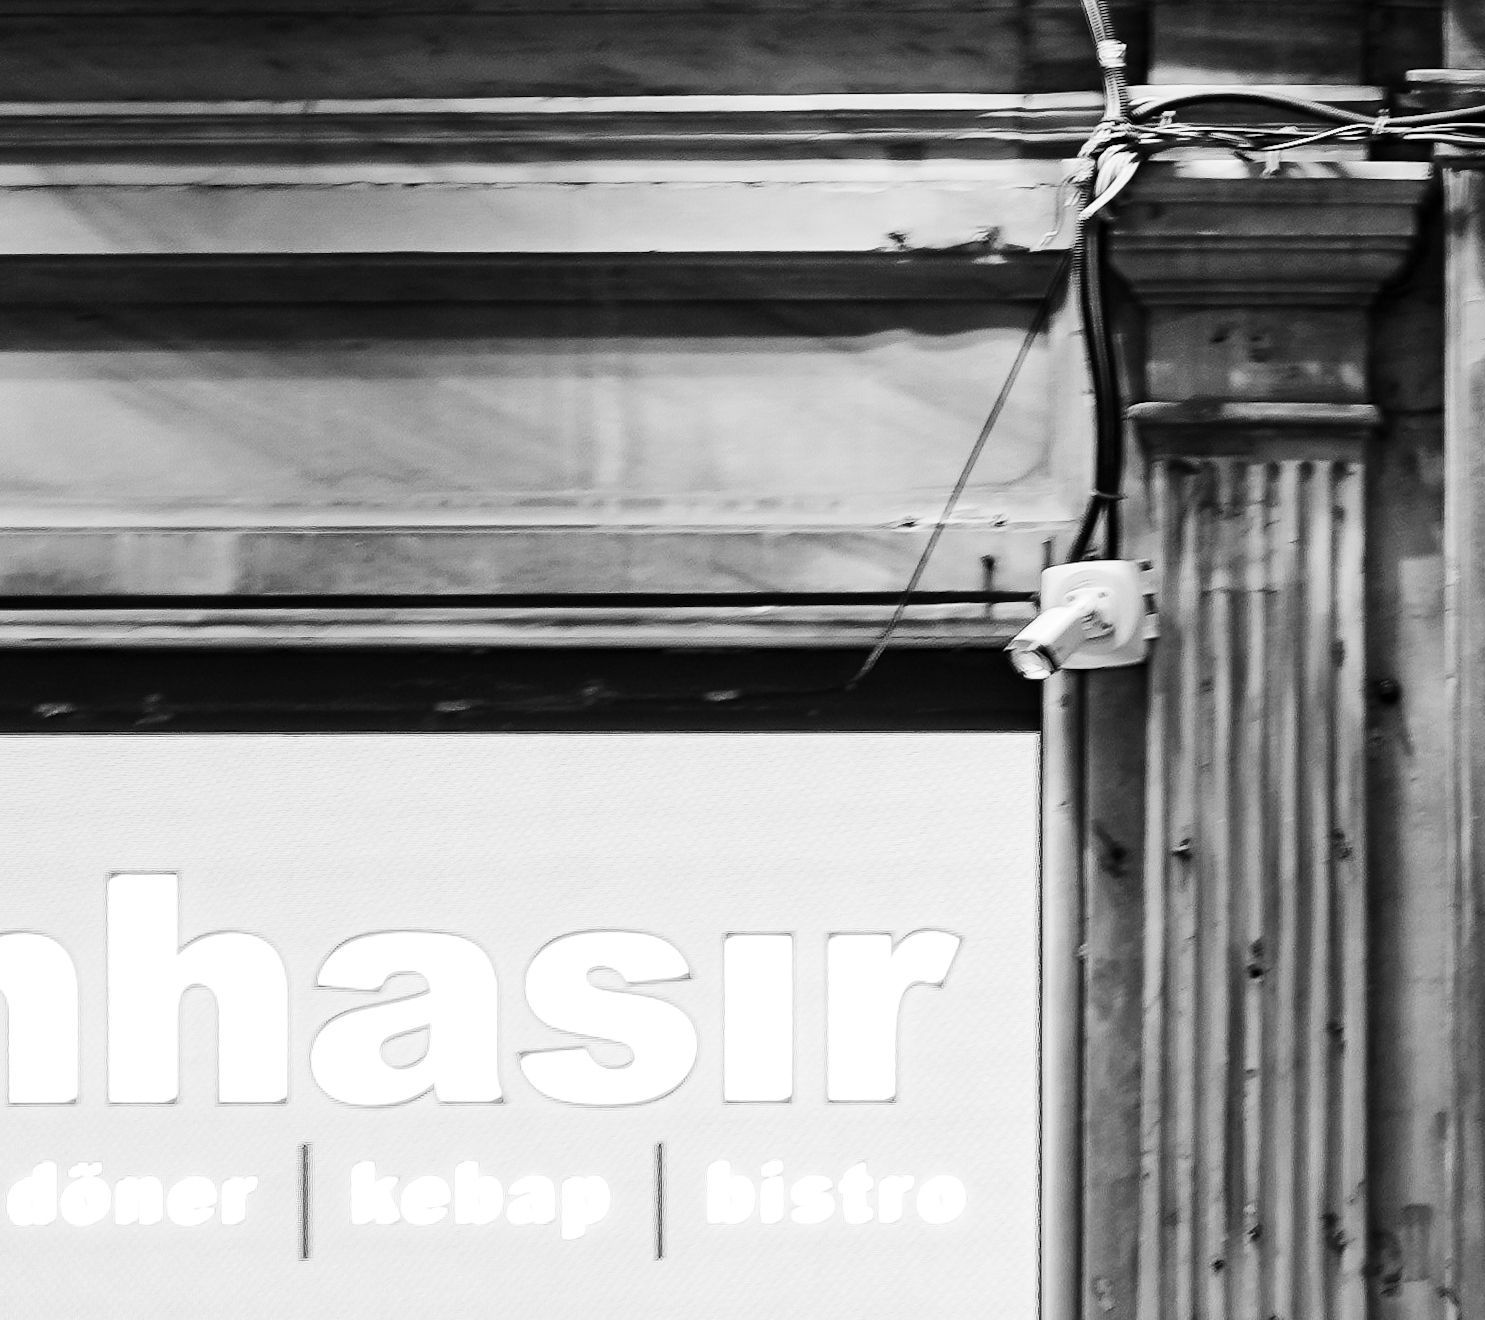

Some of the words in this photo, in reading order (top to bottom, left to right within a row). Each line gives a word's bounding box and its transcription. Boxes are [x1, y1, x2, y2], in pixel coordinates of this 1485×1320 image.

[5, 1159, 259, 1228] döner
[349, 1160, 612, 1240] kebap
[705, 1158, 968, 1226] bistro
